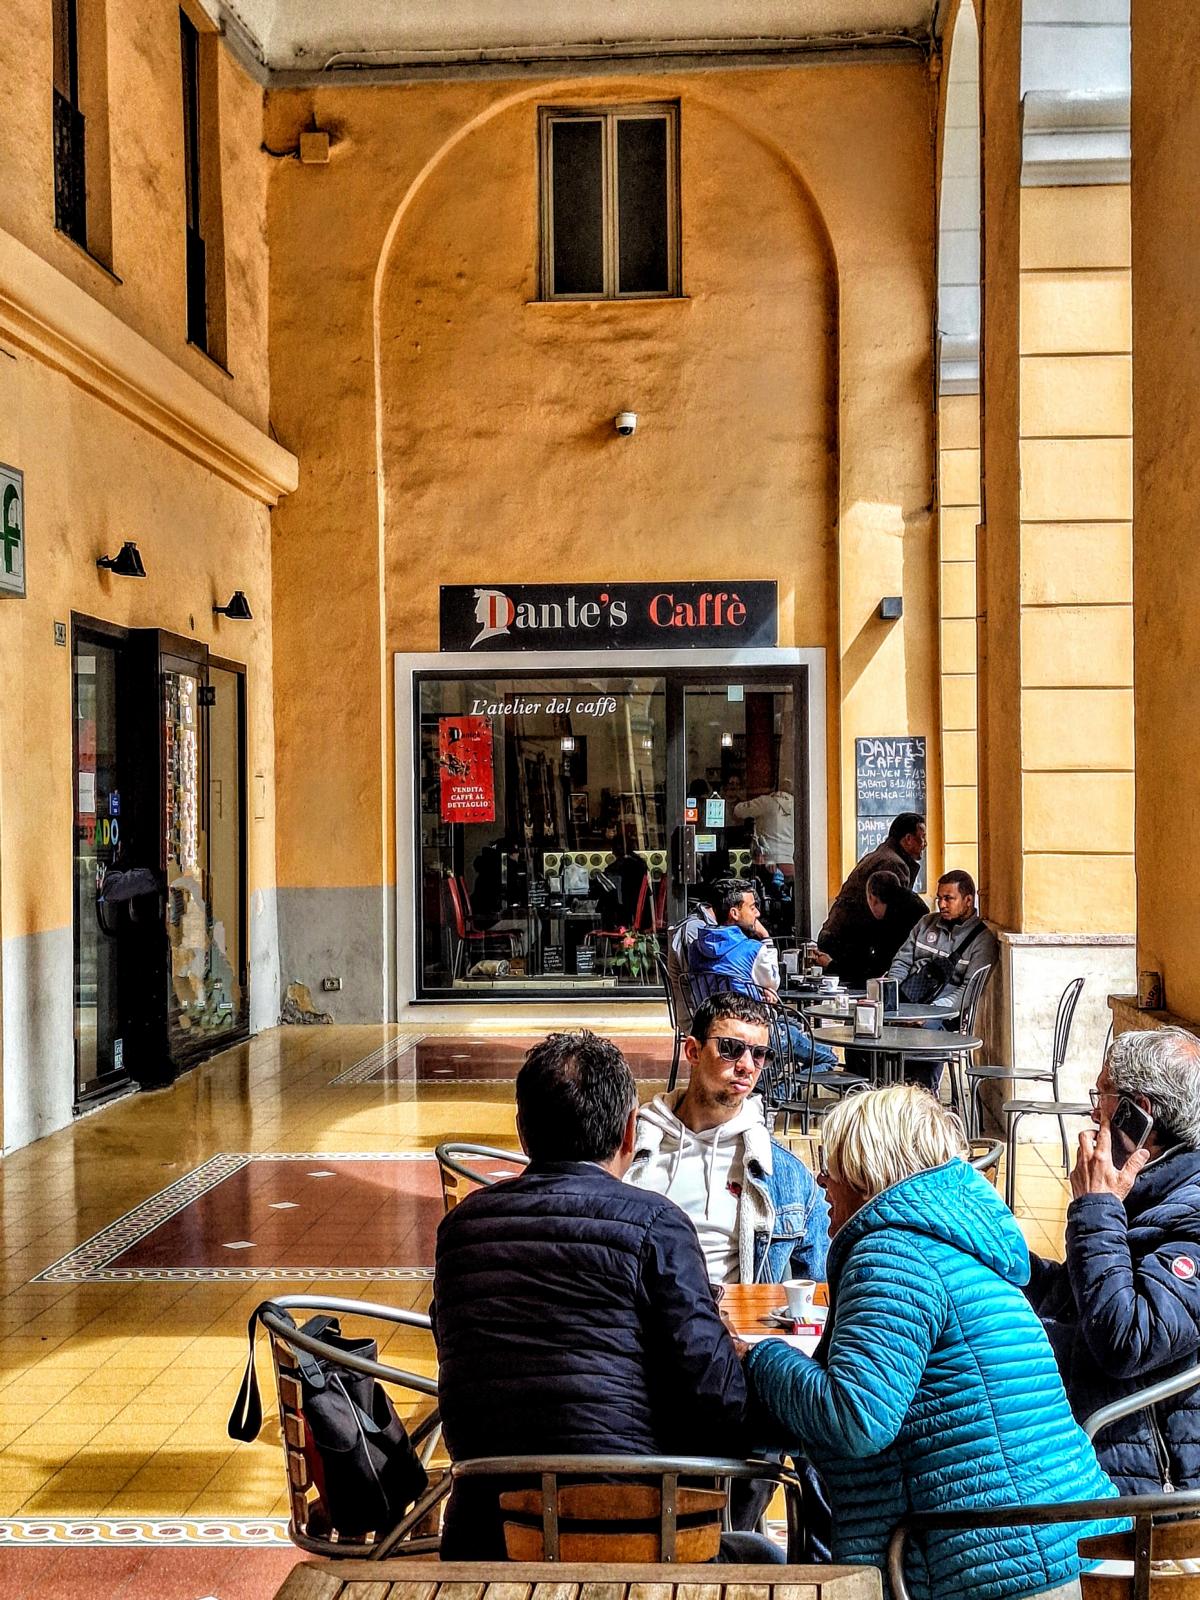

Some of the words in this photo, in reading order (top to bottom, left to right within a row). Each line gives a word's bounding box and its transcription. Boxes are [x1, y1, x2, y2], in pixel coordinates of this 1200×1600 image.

[488, 593, 628, 629] Dante's
[649, 592, 747, 628] Caffè
[471, 698, 541, 716] L'atelier
[545, 698, 571, 714] del
[576, 697, 617, 717] caffè
[858, 739, 926, 759] DANTE'S
[857, 779, 888, 789] SABATO
